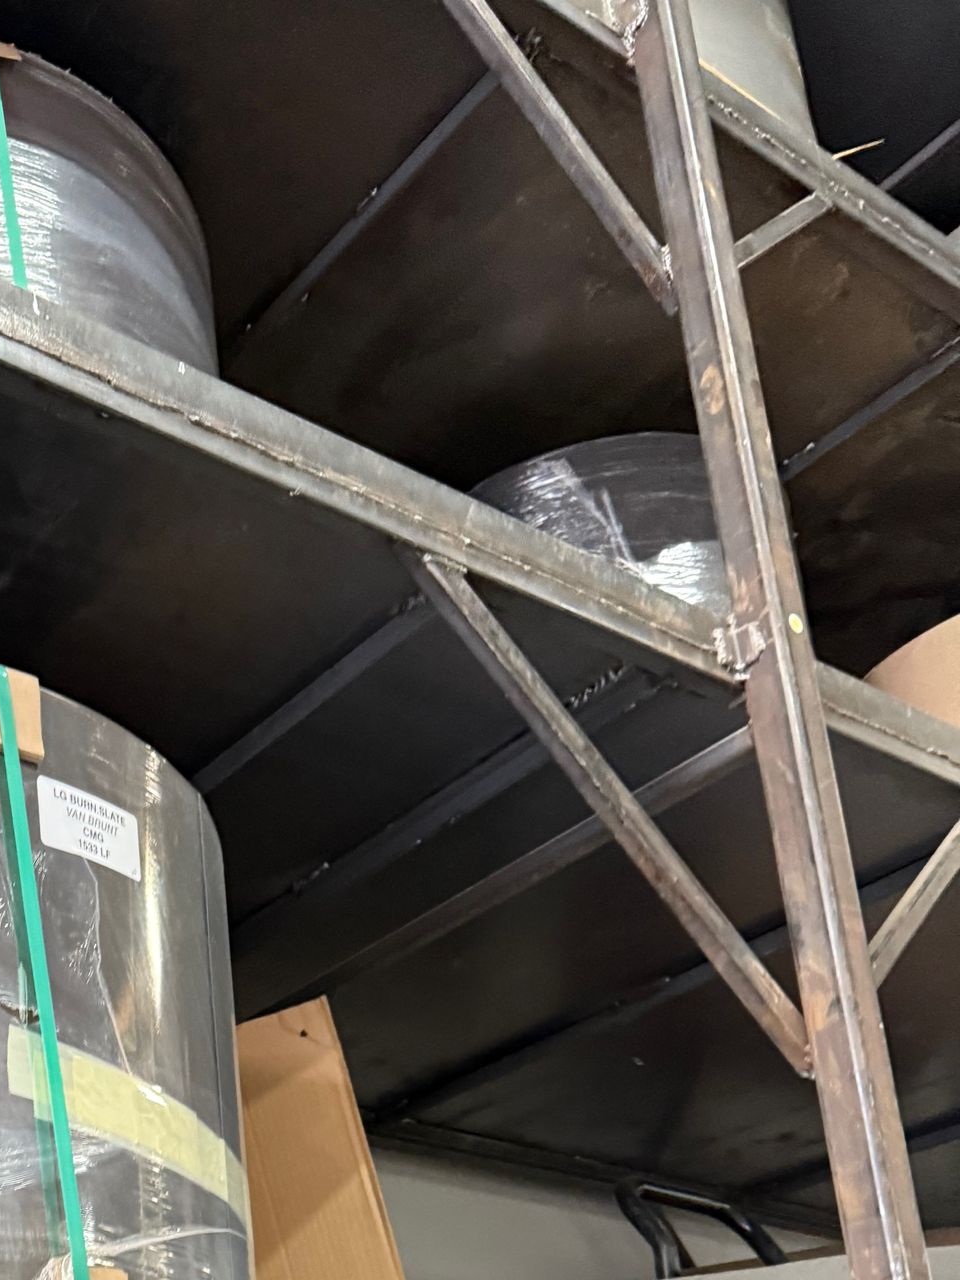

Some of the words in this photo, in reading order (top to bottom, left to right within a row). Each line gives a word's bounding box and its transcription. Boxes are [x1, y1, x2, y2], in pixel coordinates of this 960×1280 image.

[53, 787, 67, 801] LG
[66, 806, 86, 823] VAN
[87, 816, 118, 837] BRUNT
[83, 826, 104, 843] CMG
[78, 838, 98, 855] 1533
[100, 845, 111, 860] LF
